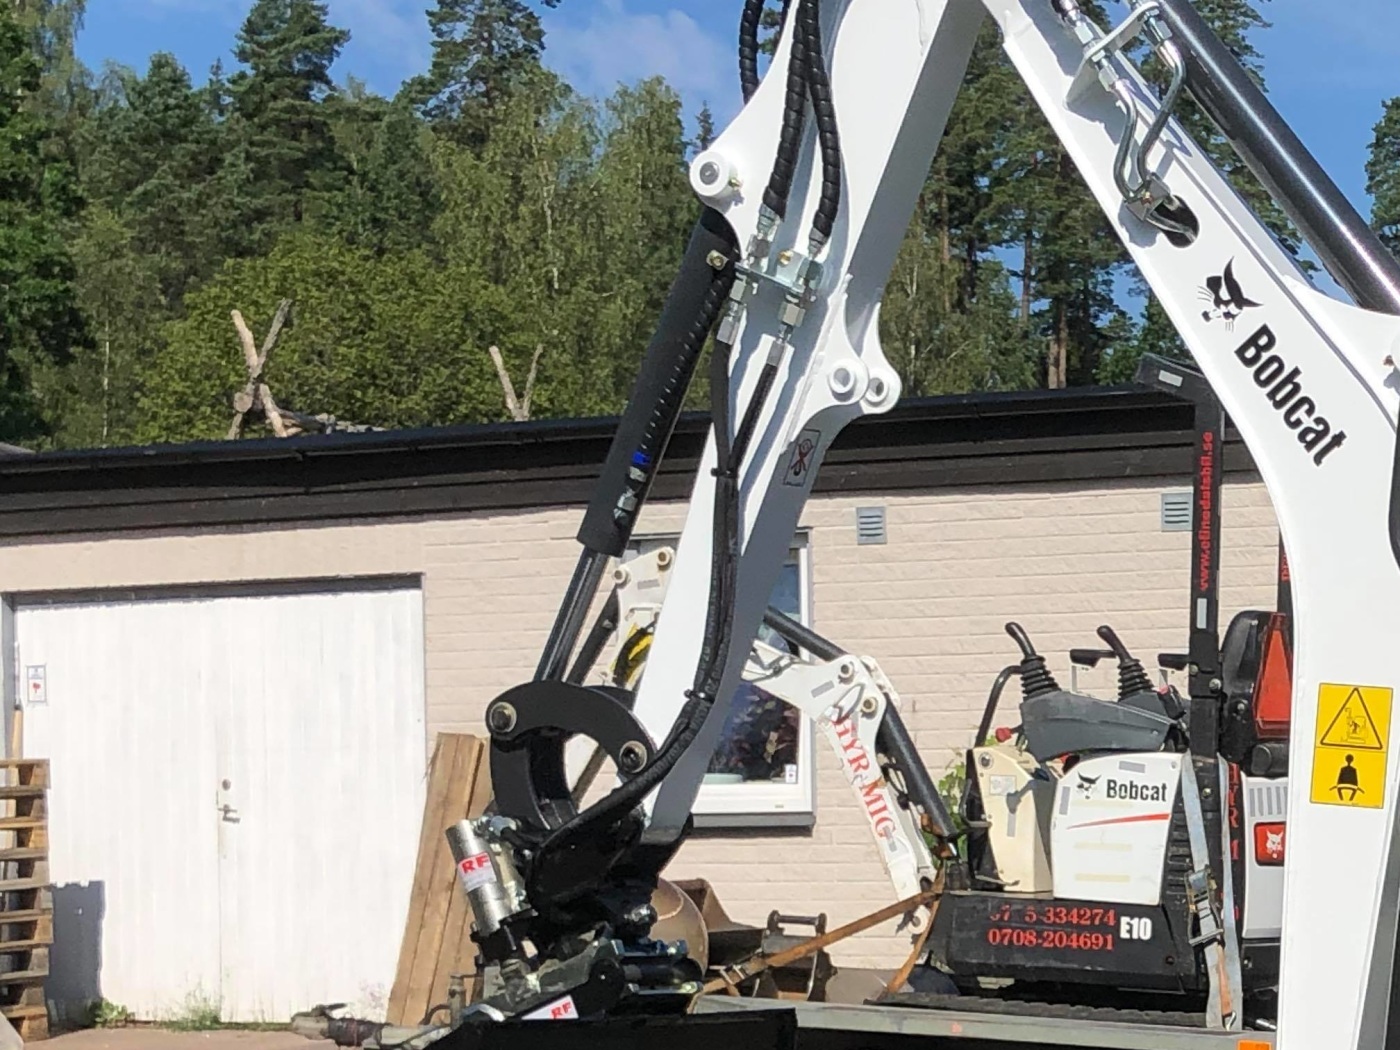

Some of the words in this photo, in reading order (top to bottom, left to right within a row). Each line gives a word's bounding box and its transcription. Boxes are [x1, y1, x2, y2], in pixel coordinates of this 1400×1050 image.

[1234, 323, 1347, 467] Bobcat
[1106, 779, 1167, 802] Bobcat
[860, 776, 896, 838] MIG
[461, 855, 490, 874] RF
[989, 904, 1117, 926] 75-334274
[988, 928, 1114, 951] 0708-204691
[1119, 916, 1152, 940] E10
[551, 1001, 573, 1019] RF
